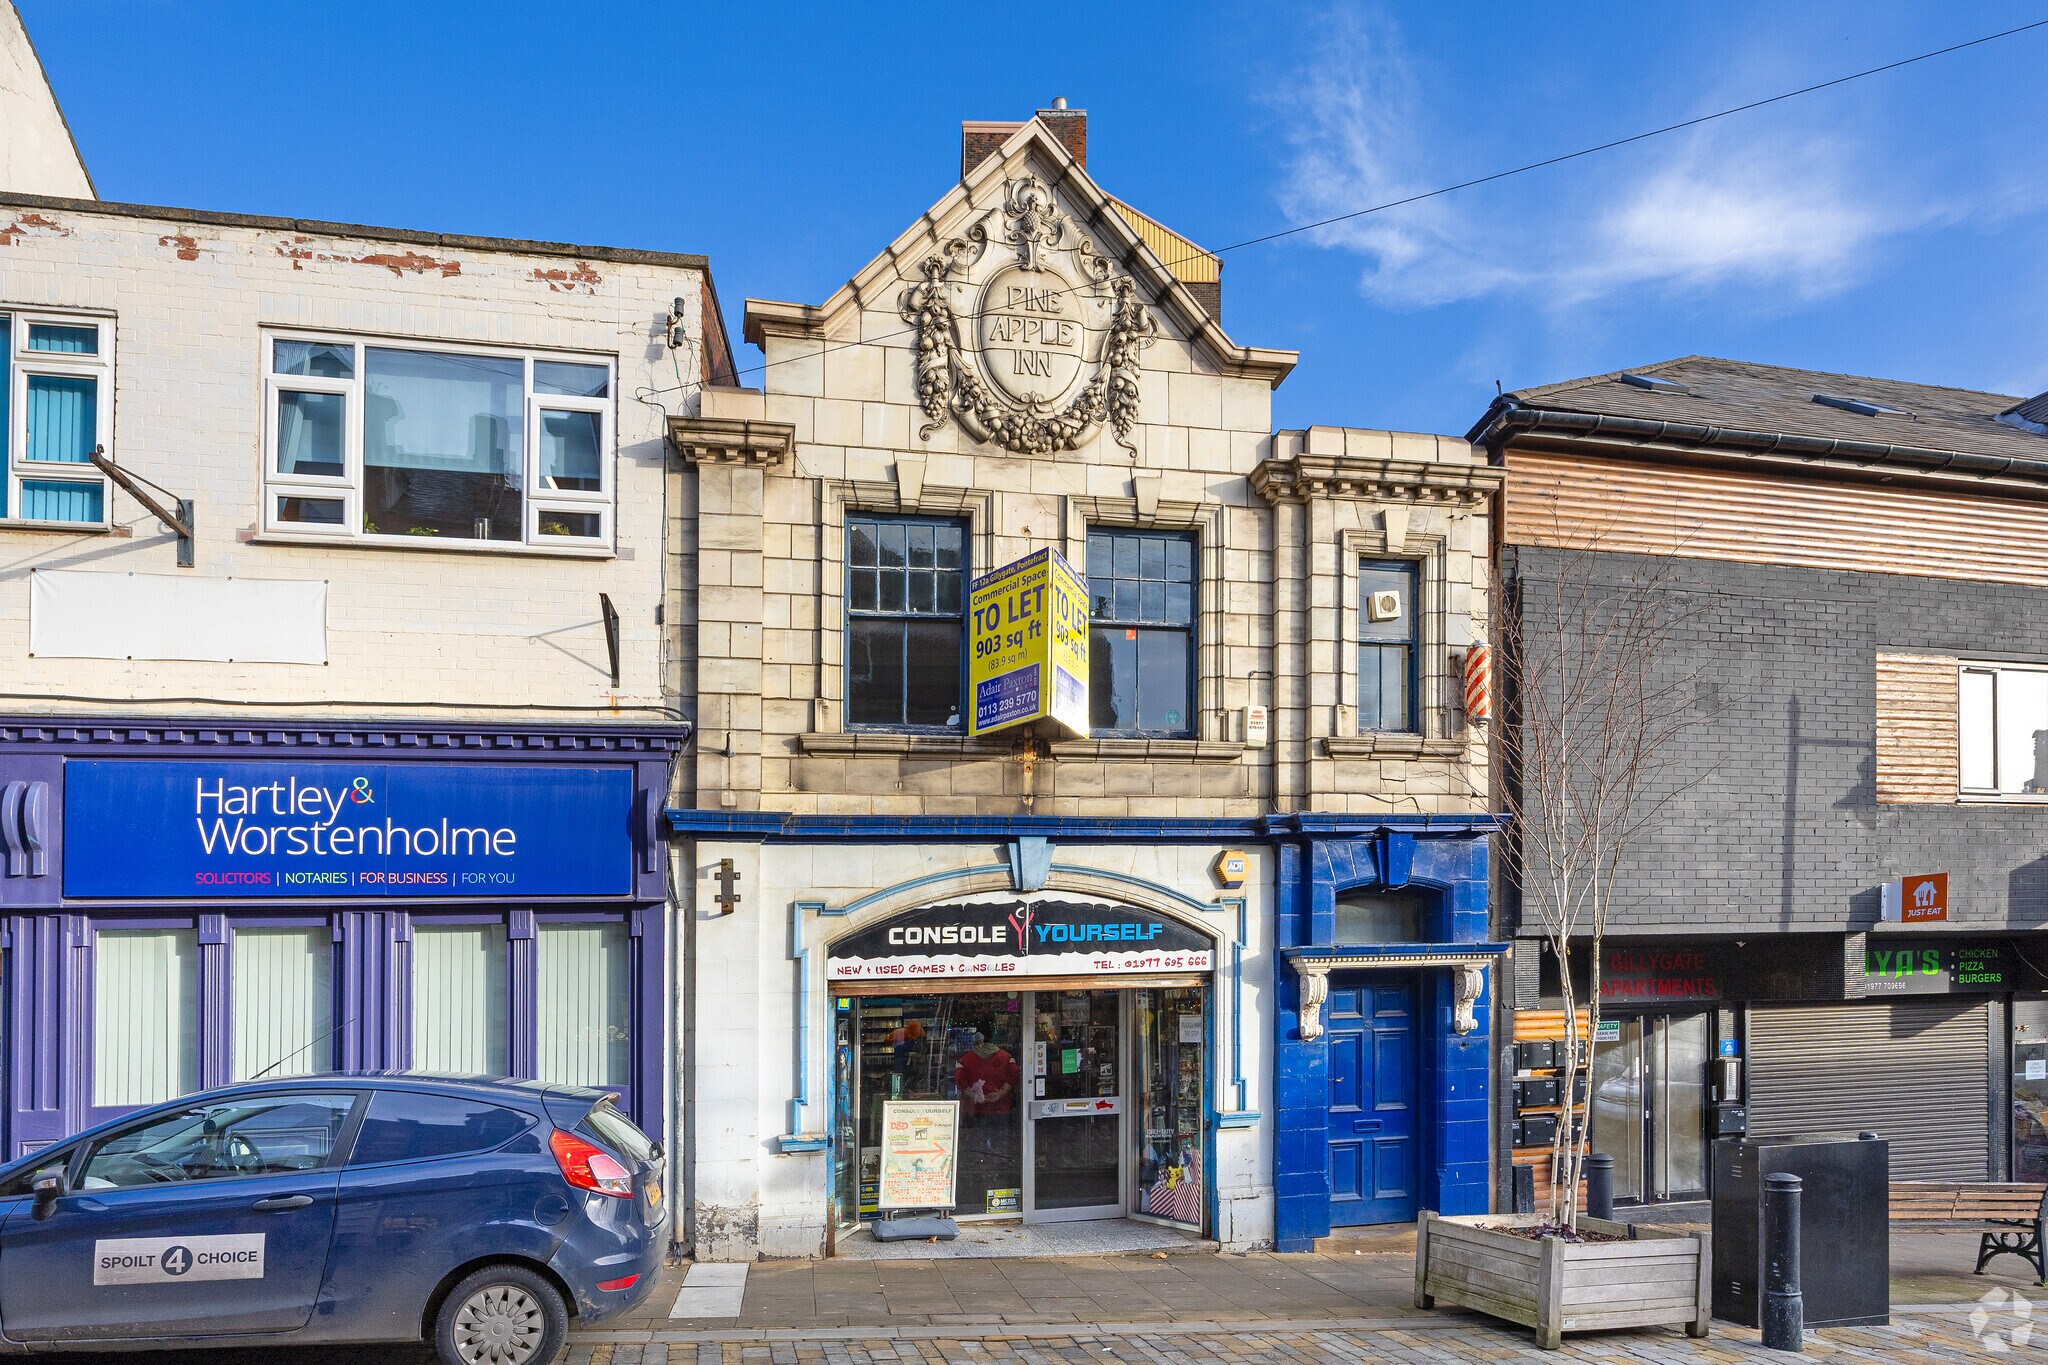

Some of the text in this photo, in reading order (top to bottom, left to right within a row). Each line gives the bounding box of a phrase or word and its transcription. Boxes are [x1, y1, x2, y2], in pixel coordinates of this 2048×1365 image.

[1007, 286, 1064, 314] PINE
[989, 316, 1075, 347] APPLE
[1013, 349, 1053, 377] INN
[1017, 551, 1048, 570] Pontefract
[973, 577, 1020, 606] Commercial
[1022, 569, 1047, 586] Space
[974, 583, 1046, 636] TO LET
[1055, 585, 1069, 621] TO
[1071, 602, 1087, 639] LET
[976, 619, 1041, 659] 903 sq ft
[1056, 621, 1068, 646] 903
[1071, 638, 1078, 660] sq
[1080, 642, 1087, 663] ft
[988, 648, 1028, 672] (83.9 sq m)
[979, 681, 1002, 699] Adair
[1003, 674, 1033, 691] Paxton
[978, 702, 998, 718] 0113
[999, 697, 1014, 712] 239
[1016, 690, 1037, 706] 5770
[978, 703, 1037, 727] www.adairpaxton.co.uk
[196, 776, 375, 827] Hartley &
[196, 817, 516, 856] Worstenholme
[1228, 861, 1244, 871] ADT
[195, 872, 515, 885] SOLICITORS NOTARIES FOR BUSINESS FOR YOU
[1907, 907, 1942, 917] JUST EAT
[888, 923, 1163, 945] CONSOLE YOURSELF
[1125, 957, 1160, 968] 01977
[1165, 957, 1184, 968] 695
[1188, 957, 1207, 966] 666
[1610, 951, 1704, 972] GILLYGATE
[1959, 950, 1998, 959] CHICKEN
[1959, 962, 1984, 971] PIZZA
[837, 965, 862, 975] NEW
[876, 964, 904, 974] USED
[909, 964, 946, 974] GAMES
[1959, 973, 2002, 984] BURGERS
[1600, 977, 1717, 997] APARTMENTS
[1598, 1022, 1618, 1030] AFETY
[101, 1248, 258, 1273] SPOILT 4 CHOICE
